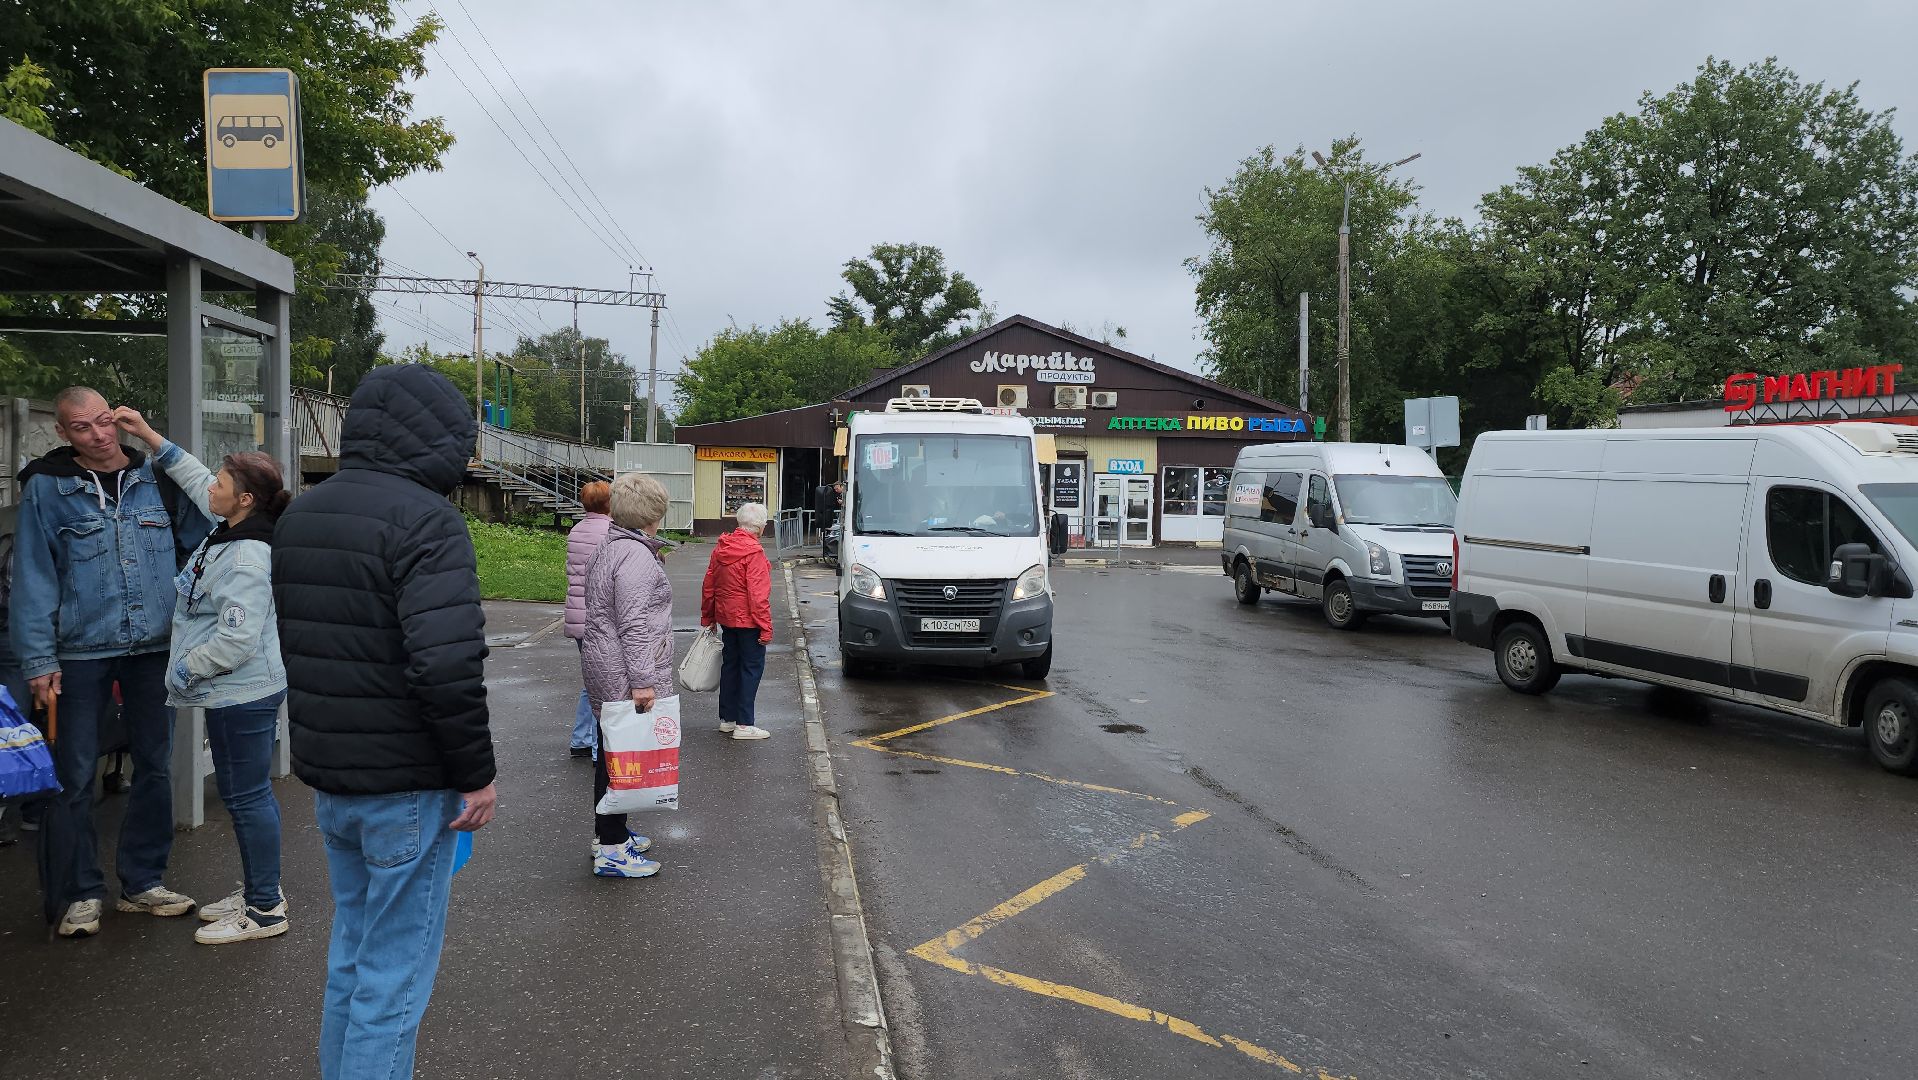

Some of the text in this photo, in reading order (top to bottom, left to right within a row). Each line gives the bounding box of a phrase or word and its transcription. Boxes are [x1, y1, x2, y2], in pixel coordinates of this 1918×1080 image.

[970, 351, 1096, 375] Марийка
[1040, 372, 1092, 381] ПРОДУКТЫ
[1763, 364, 1903, 403] МАГНИТ
[1107, 415, 1307, 433] АПТЕКА ПИВО РЫБА
[1109, 459, 1143, 474] ВХОД
